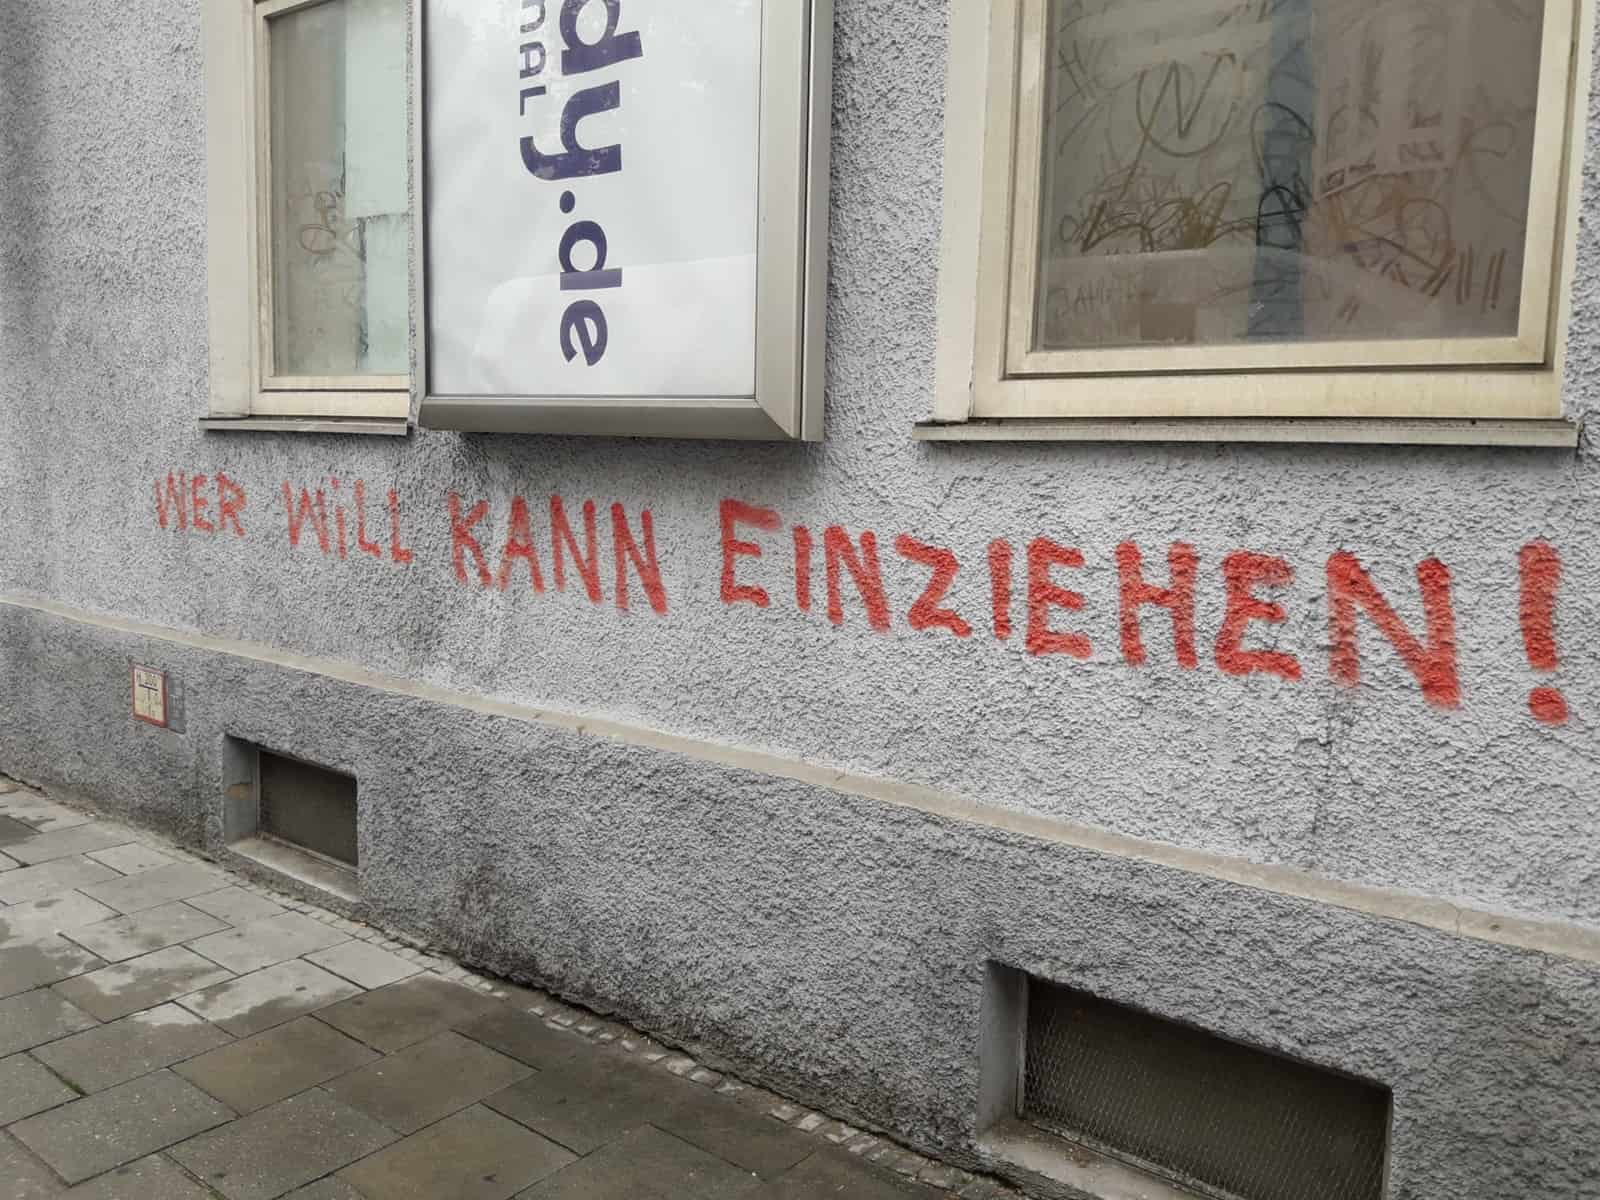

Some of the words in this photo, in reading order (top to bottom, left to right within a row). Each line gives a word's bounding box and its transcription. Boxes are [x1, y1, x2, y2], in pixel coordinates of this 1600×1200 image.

[154, 470, 247, 536] WER
[447, 491, 668, 616] KANN
[718, 498, 1569, 725] EINZIEHEN!
